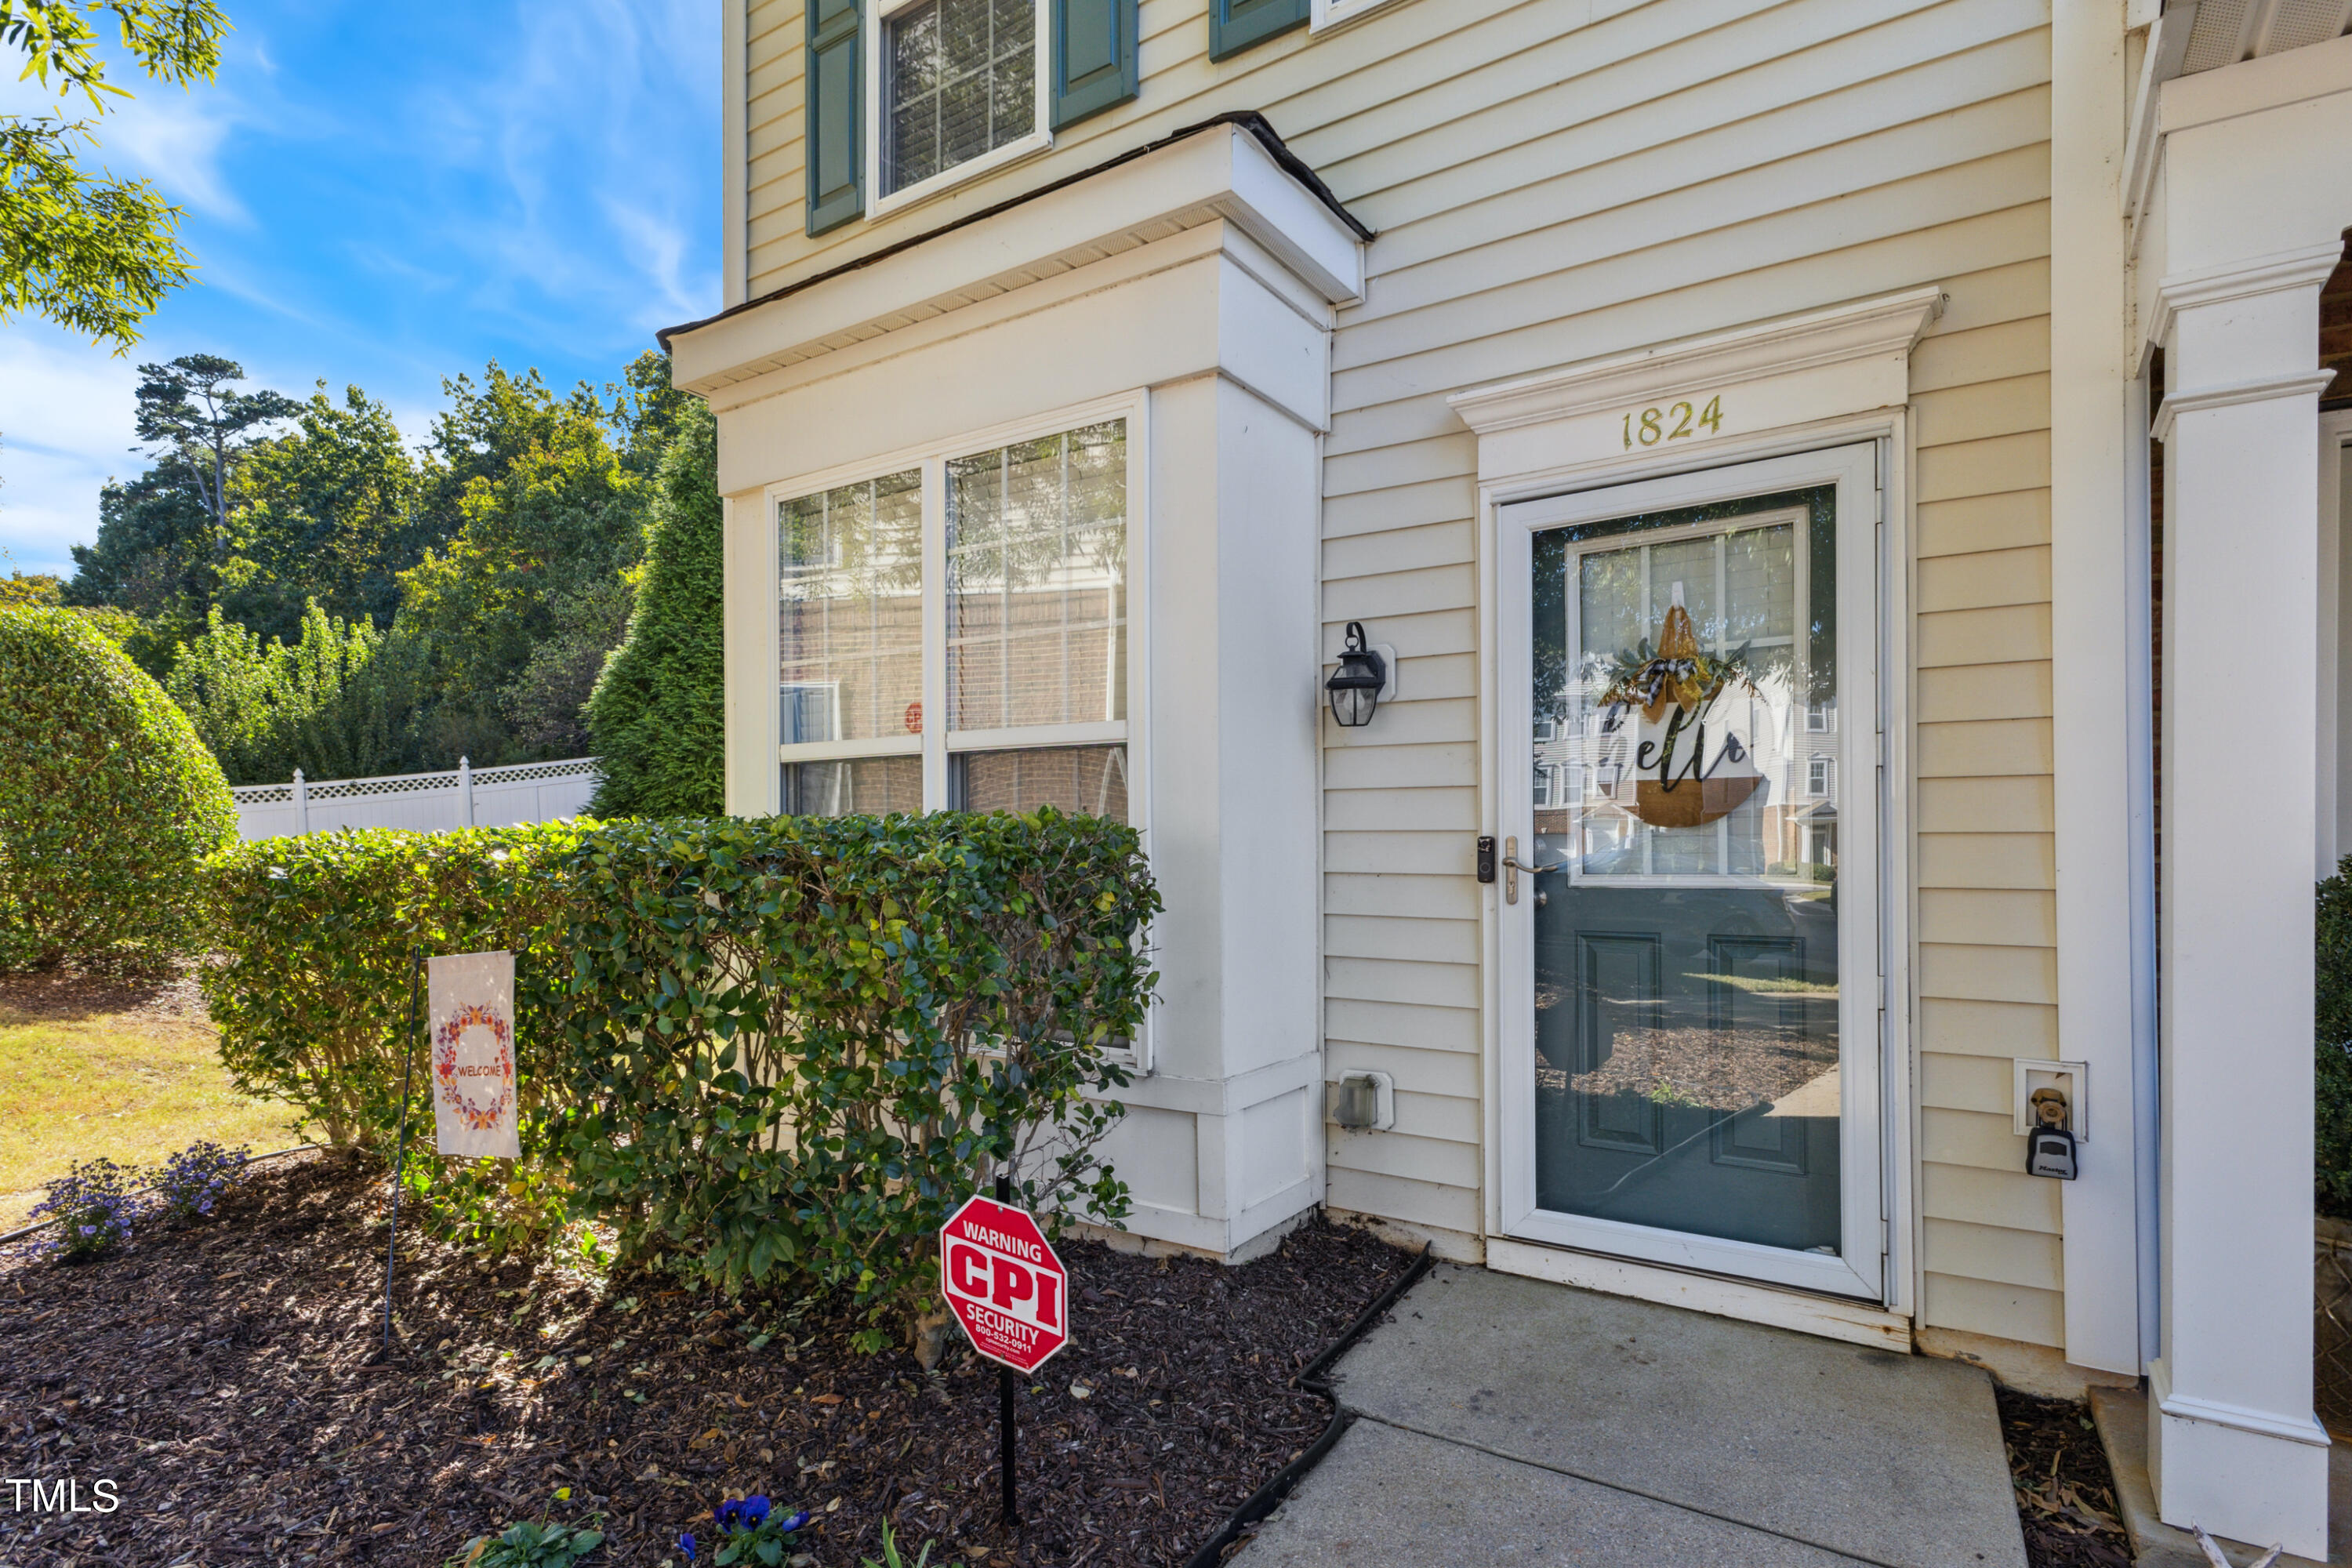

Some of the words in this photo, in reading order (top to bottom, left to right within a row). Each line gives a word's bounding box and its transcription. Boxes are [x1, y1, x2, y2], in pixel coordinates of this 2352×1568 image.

[1623, 394, 1723, 452] 1824
[458, 1065, 501, 1076] WELCOME
[963, 1220, 1042, 1262] WARNING
[950, 1243, 1058, 1328] CPI
[967, 1303, 1039, 1345] SECURITY
[975, 1324, 1031, 1353] 800-532-0911
